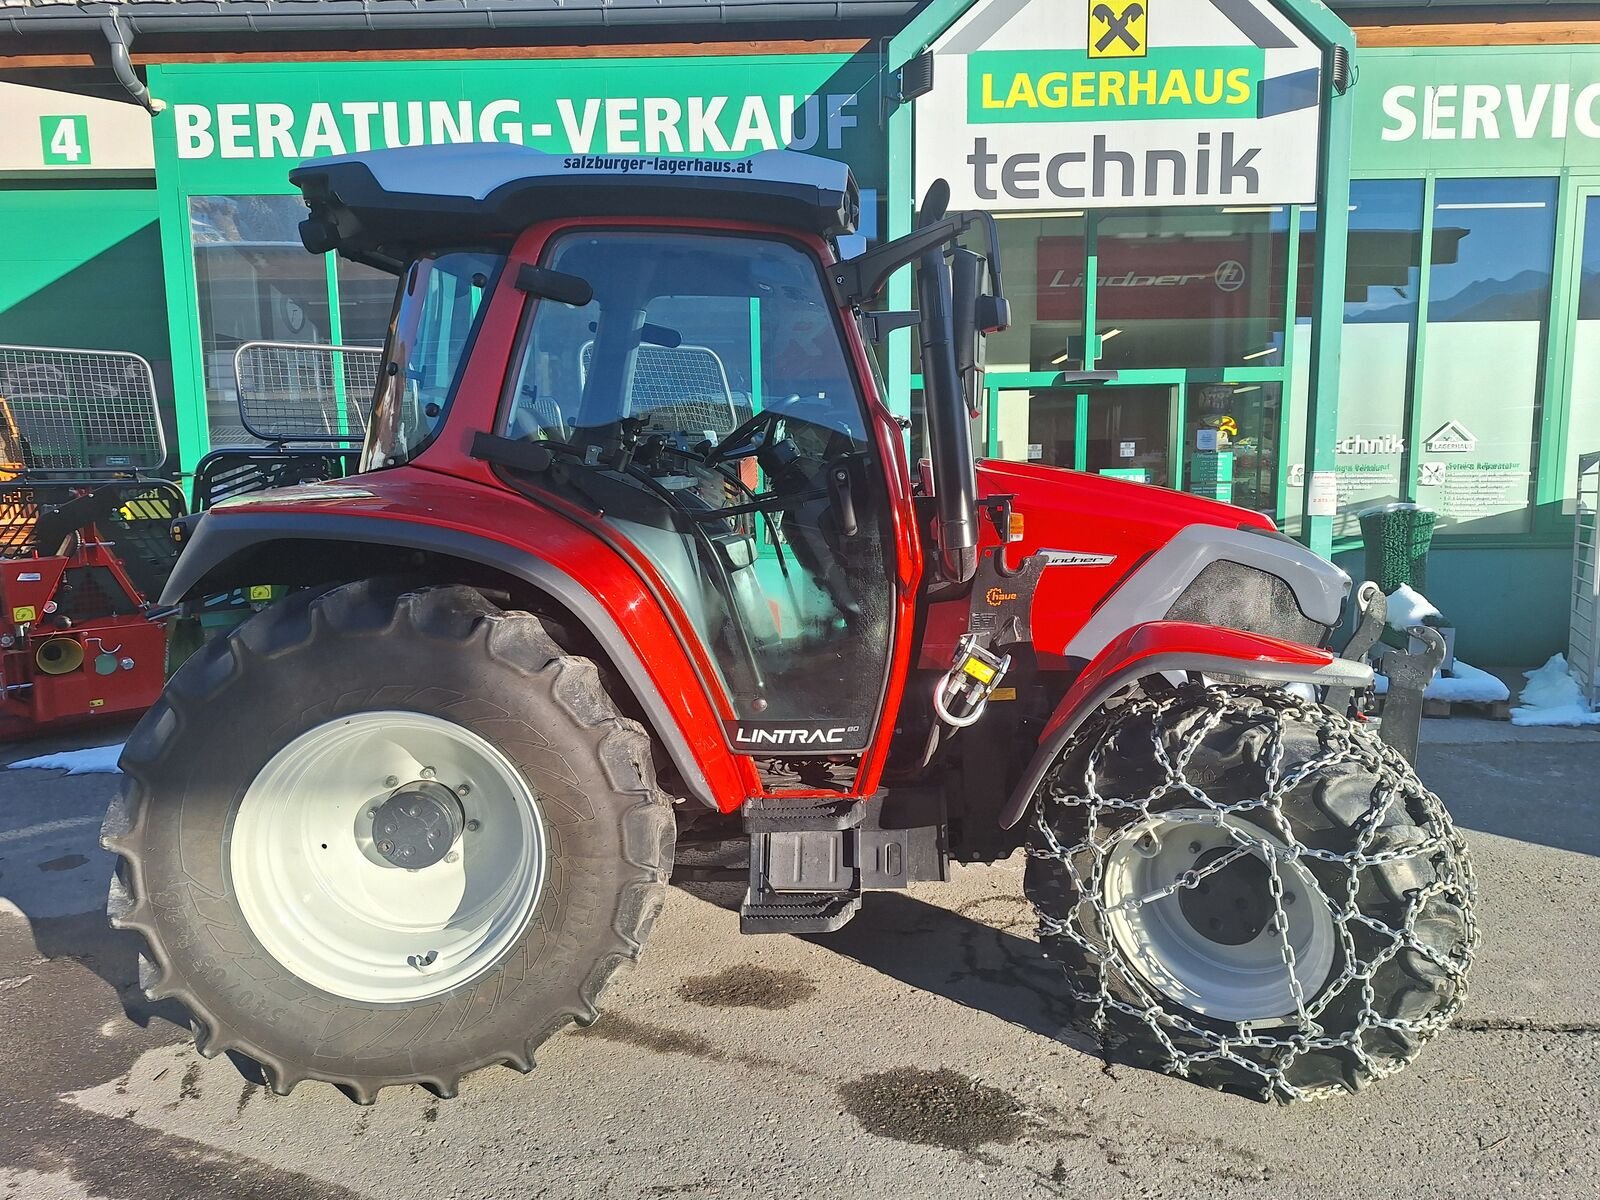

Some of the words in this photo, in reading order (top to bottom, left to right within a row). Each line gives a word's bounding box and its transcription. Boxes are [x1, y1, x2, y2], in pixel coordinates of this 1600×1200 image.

[981, 68, 1251, 109] LAGERHAUS
[51, 118, 82, 161] 4
[562, 154, 753, 174] salzburger-lagerhaus.at
[966, 132, 1262, 200] technik
[1051, 555, 1104, 564] indner
[991, 590, 1018, 601] haue
[735, 727, 846, 744] LINTRAC
